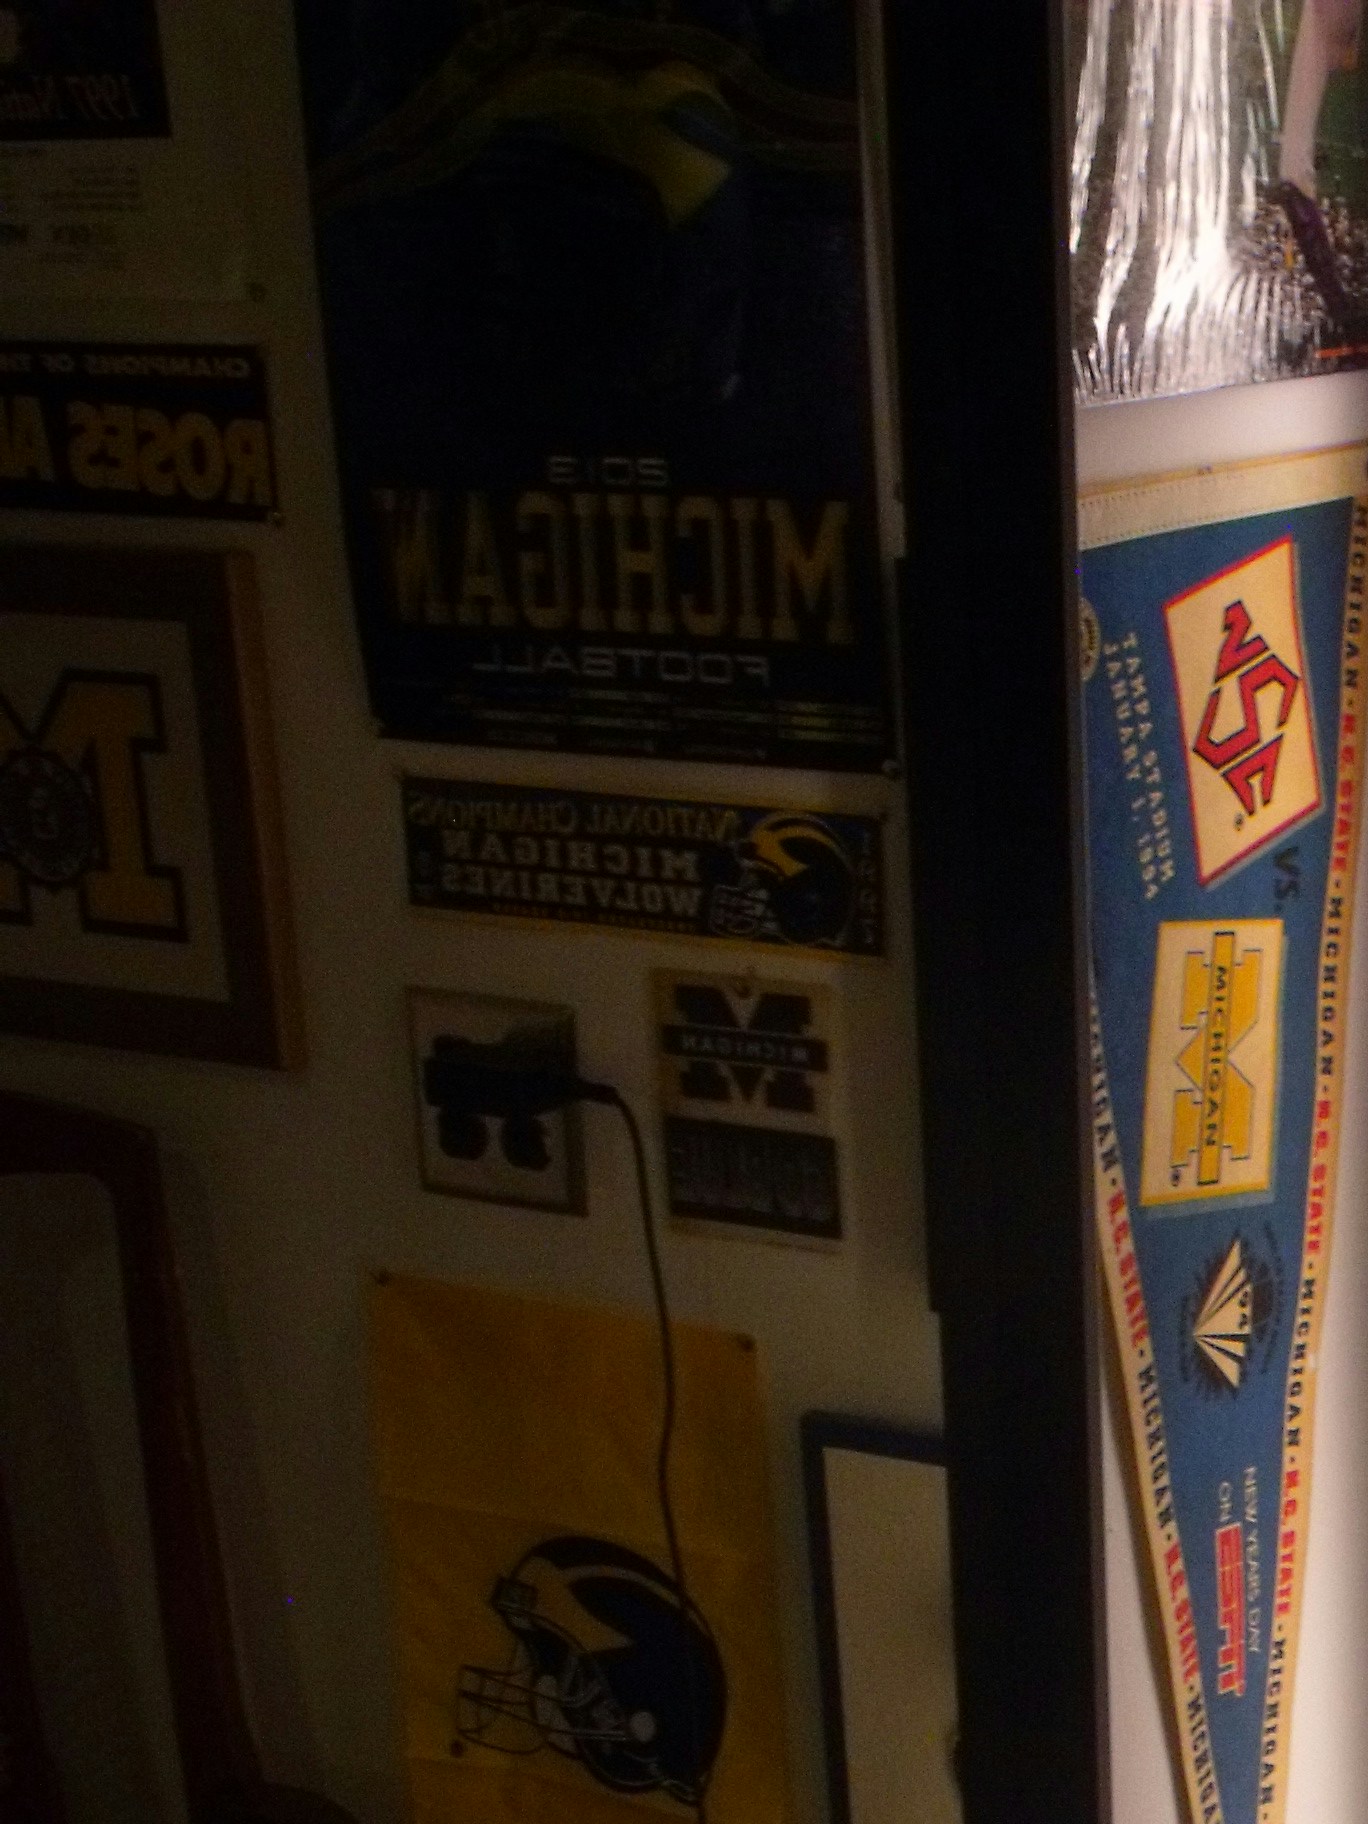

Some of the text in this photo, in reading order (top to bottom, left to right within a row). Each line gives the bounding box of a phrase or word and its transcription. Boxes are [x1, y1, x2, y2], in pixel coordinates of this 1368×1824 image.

[1344, 503, 1368, 690] MICHIGAN
[1102, 642, 1138, 782] JANUARY
[1122, 632, 1176, 883] TAMPA STADIUM
[1332, 780, 1354, 872] STATE
[1203, 964, 1228, 1149] MICHIGAN
[1318, 896, 1344, 1077] MICHIGAN
[1305, 1164, 1328, 1255] STATE
[1286, 1277, 1317, 1447] MICHIGAN
[1119, 1252, 1150, 1347] STATE
[1137, 1363, 1174, 1531] MICHIGAN
[1175, 1606, 1201, 1684] STATE
[1214, 1481, 1246, 1696] ON ESPN
[1243, 1465, 1262, 1653] NEW YEARS DAY
[1276, 1531, 1297, 1616] STATE
[1258, 1637, 1288, 1806] MICHIGAN
